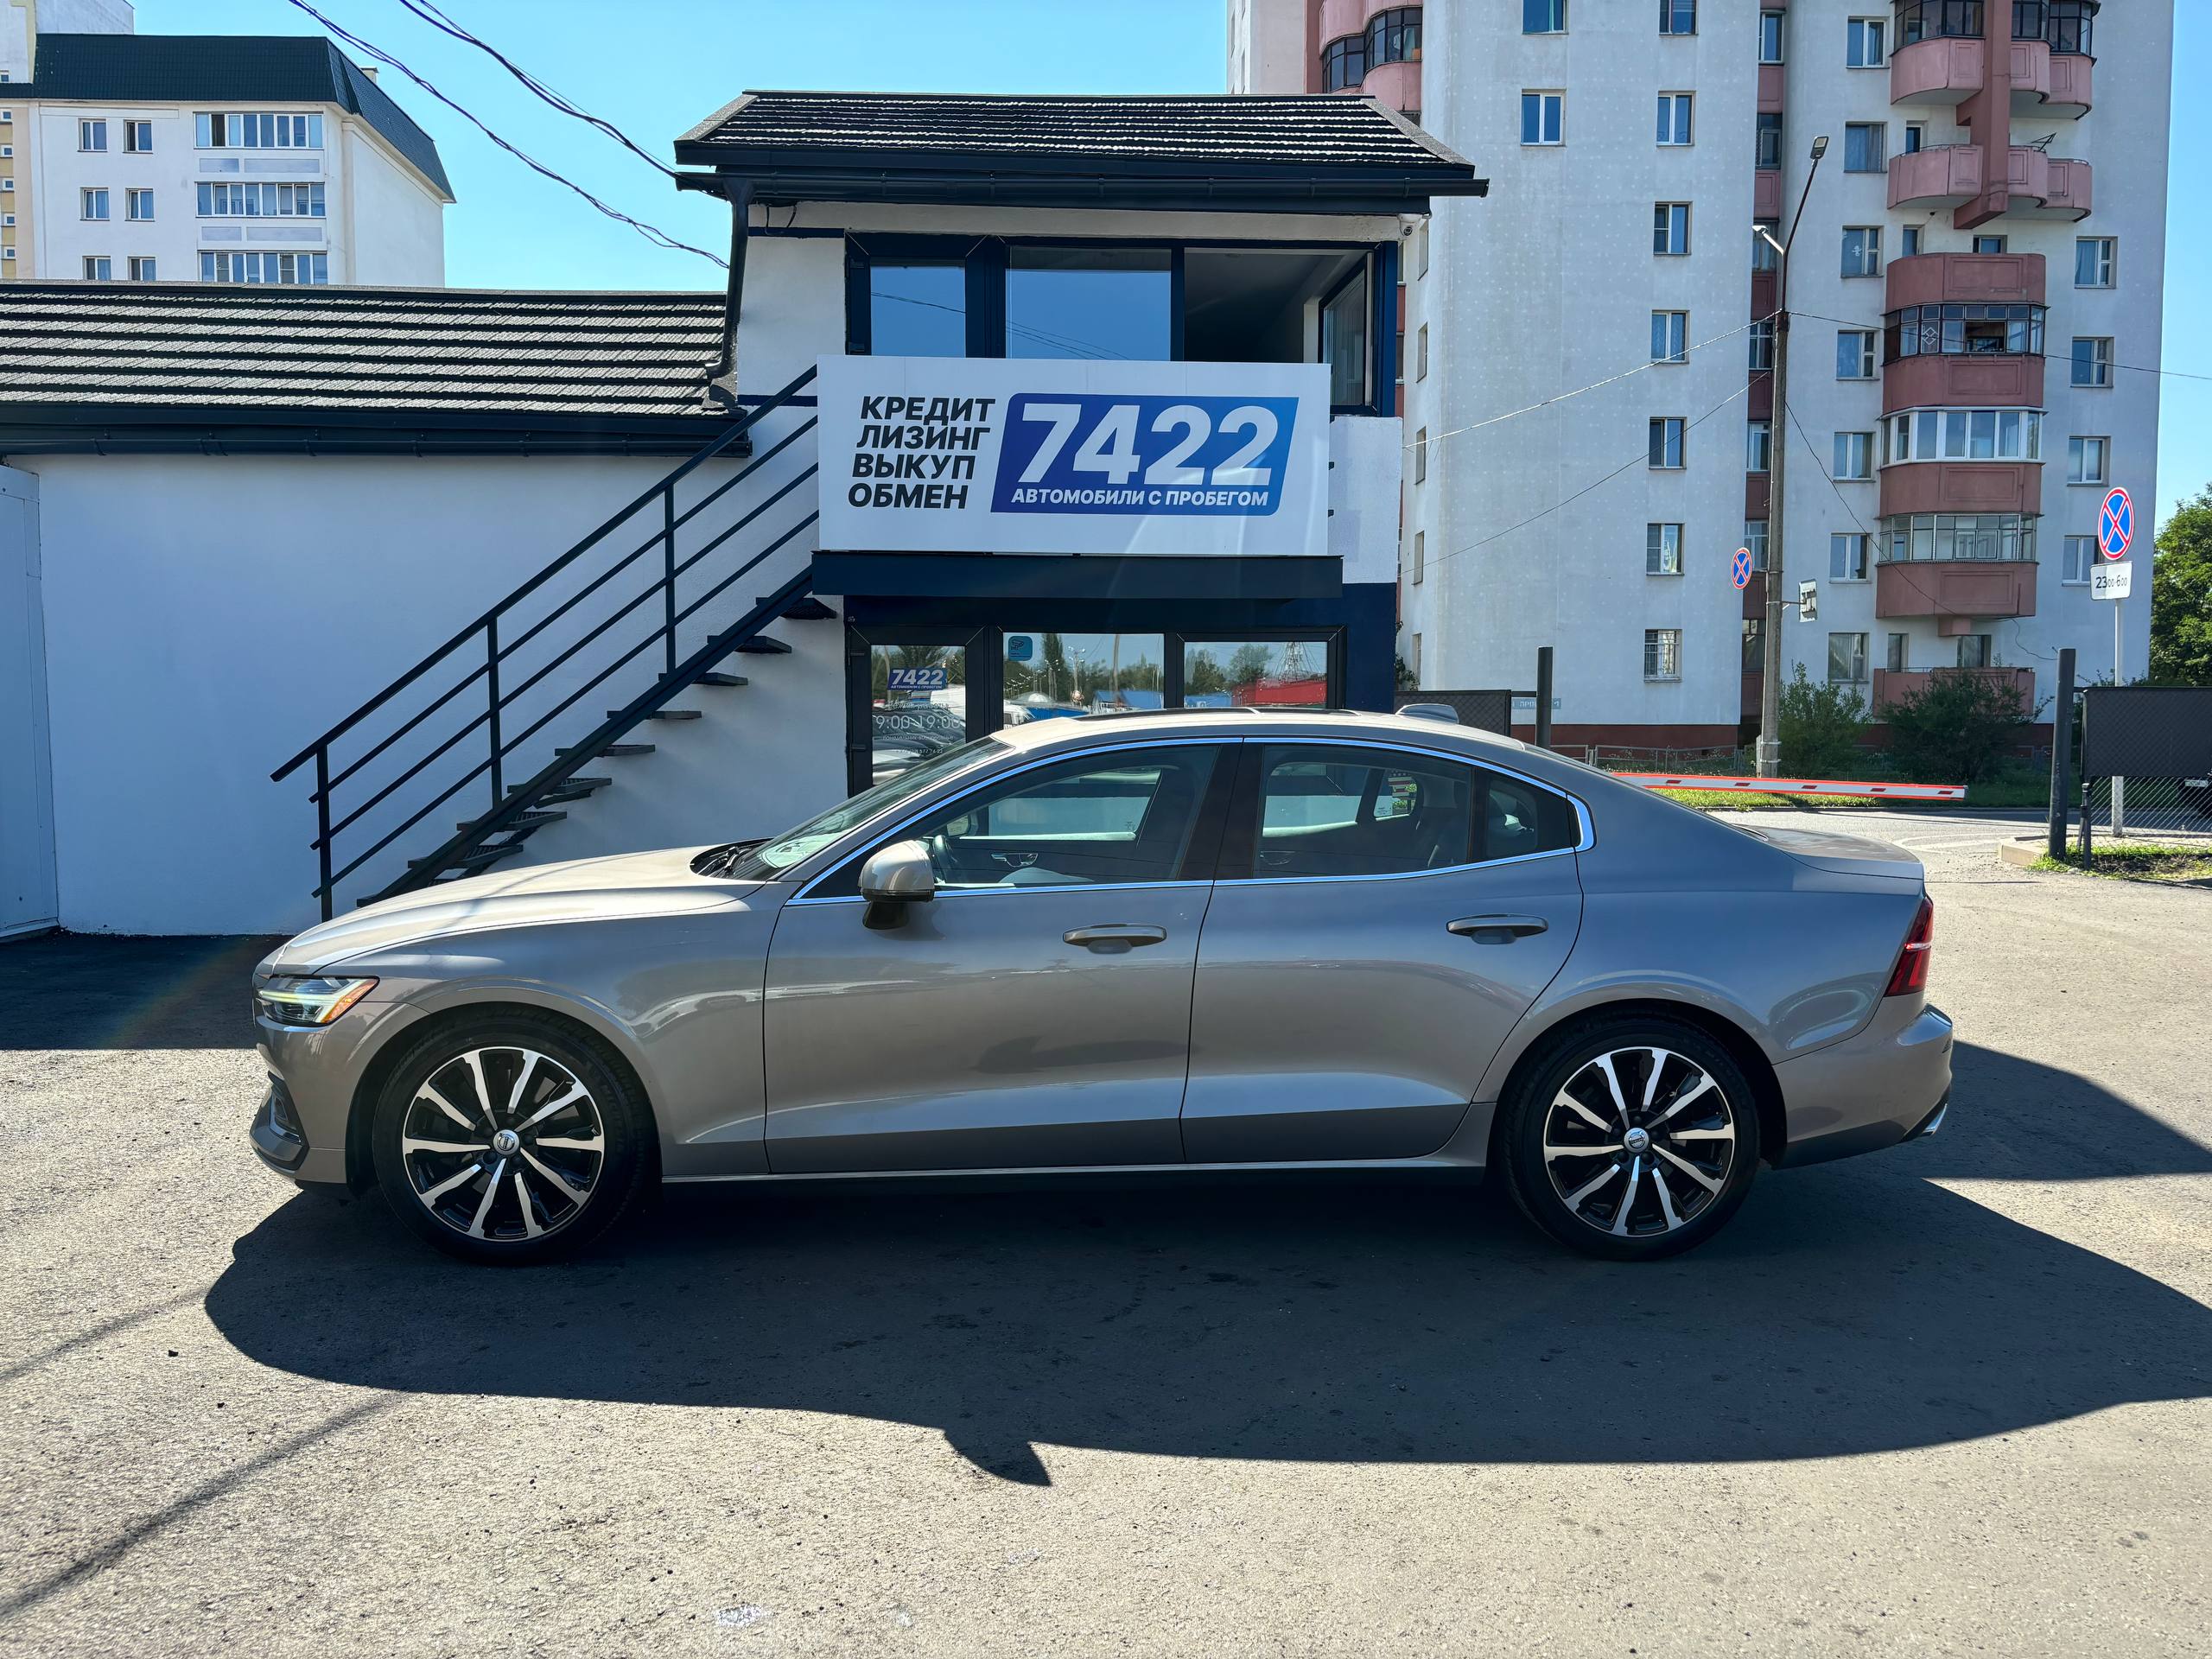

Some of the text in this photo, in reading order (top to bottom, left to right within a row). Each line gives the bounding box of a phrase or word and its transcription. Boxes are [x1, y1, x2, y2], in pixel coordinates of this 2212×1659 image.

[861, 396, 995, 425] КРЕДИТ
[856, 425, 990, 450] ЛИЗИНГ
[1018, 404, 1278, 486] 7422
[851, 454, 976, 480] ВЫКУП
[848, 483, 969, 510] ОБМЕН
[1011, 488, 1268, 506] АВТОМОБИЛИ С ПРОБЕГОМ
[892, 670, 944, 685] 7422
